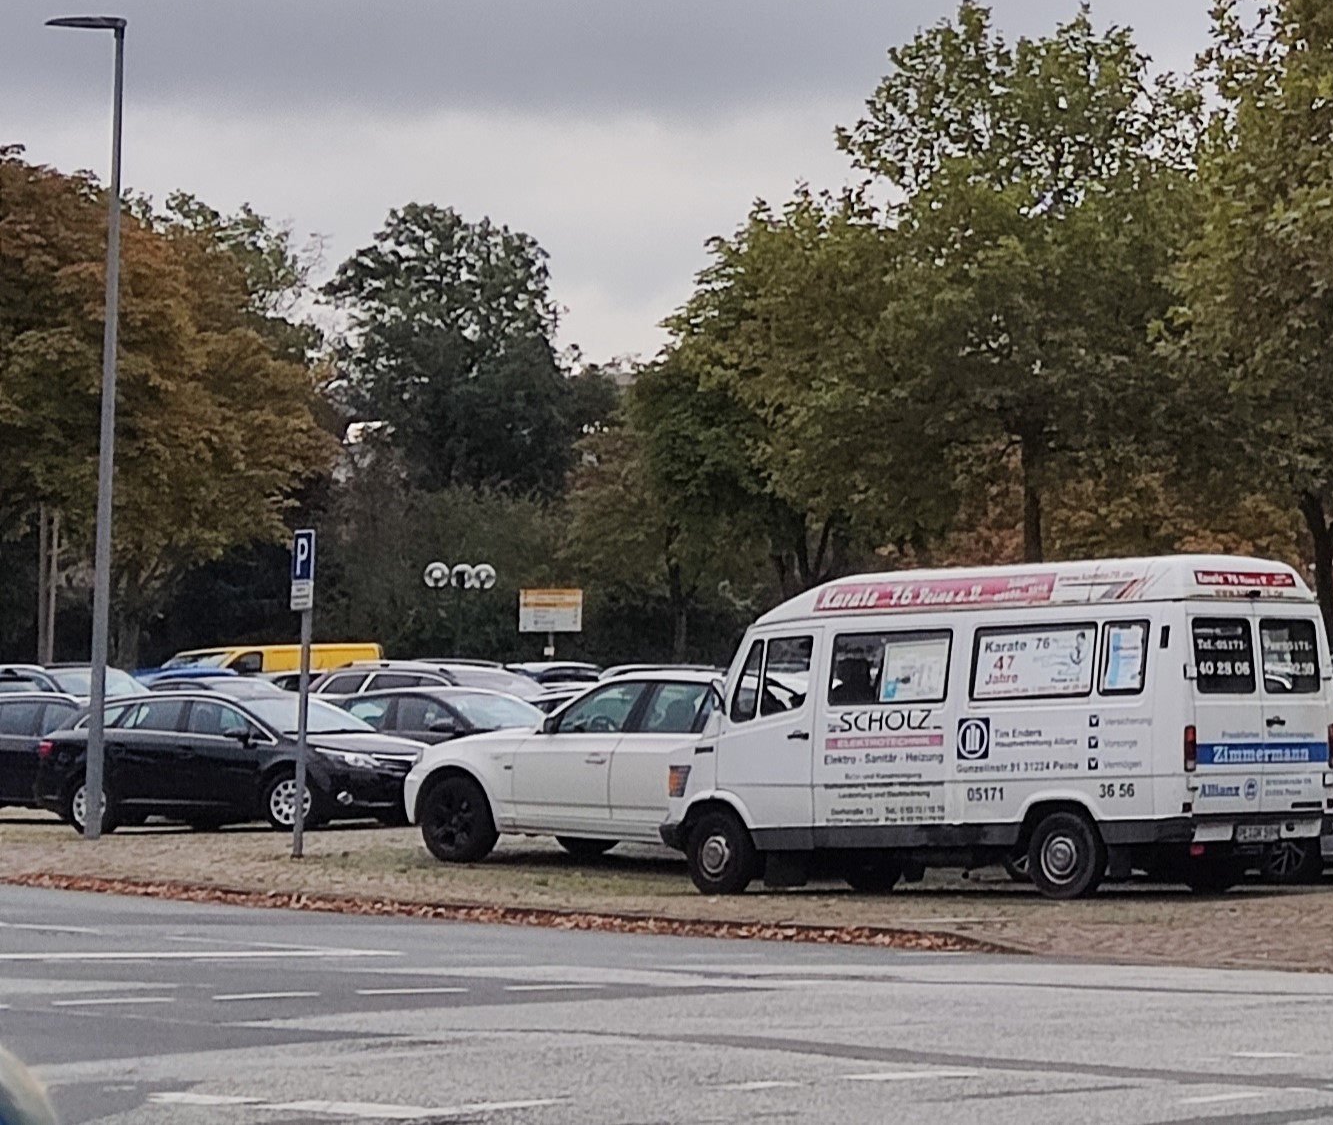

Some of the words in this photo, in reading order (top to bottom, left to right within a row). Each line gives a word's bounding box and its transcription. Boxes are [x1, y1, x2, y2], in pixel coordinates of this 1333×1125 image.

[295, 537, 309, 577] P
[819, 586, 880, 610] Karate
[984, 639, 1027, 653] Karate
[1035, 637, 1051, 650] 76
[993, 655, 1015, 672] 47
[1199, 661, 1214, 675] 40
[1216, 661, 1232, 675] 28
[985, 672, 1018, 686] Jahre
[839, 709, 932, 733] SCHOLZ
[1104, 717, 1153, 727] Versicherung
[1012, 728, 1042, 738] Enders
[836, 736, 930, 749] ELEKTROTECHNIK
[1054, 737, 1079, 746] Allianz
[1103, 738, 1138, 749] Vorsorge
[824, 755, 857, 766] Elektro
[905, 752, 944, 765] Heizung
[1212, 745, 1310, 764] Zimmermann
[1023, 760, 1051, 772] 31224
[1052, 760, 1079, 771] Peine
[1103, 759, 1142, 771] Vermögen
[967, 786, 1004, 802] 05171
[1099, 783, 1115, 799] 36
[1118, 782, 1135, 798] 56
[1199, 783, 1240, 798] Allianz
